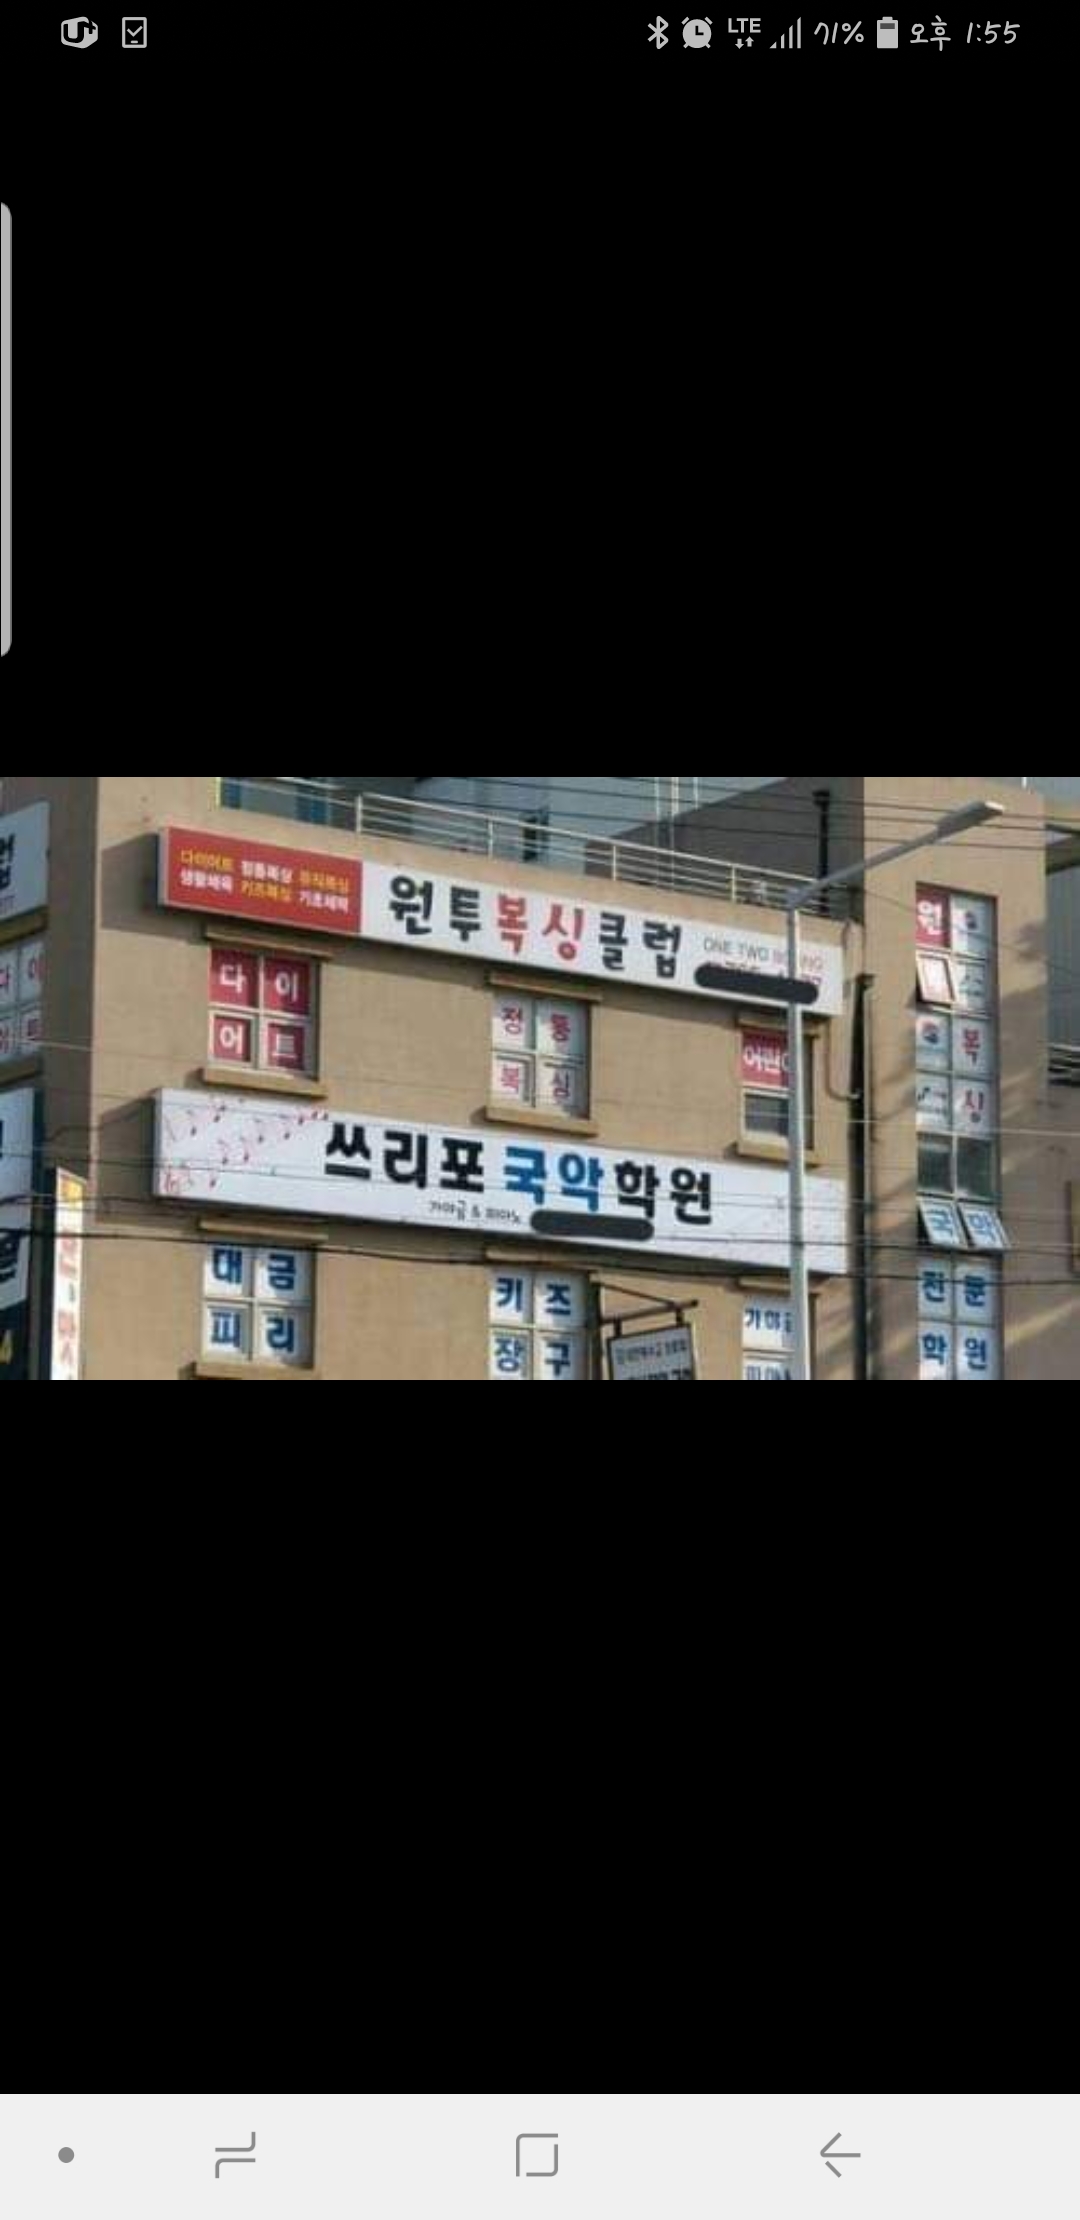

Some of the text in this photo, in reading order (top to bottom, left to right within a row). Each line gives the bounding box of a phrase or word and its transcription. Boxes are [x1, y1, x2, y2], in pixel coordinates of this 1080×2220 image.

[727, 17, 762, 34] LTE
[813, 20, 865, 46] 71%
[909, 15, 1021, 52] 오후 1:55
[704, 937, 733, 954] ONE
[736, 942, 769, 961] TWO
[325, 1122, 485, 1193] 쓰리포
[497, 1278, 571, 1316] 키즈
[495, 1338, 572, 1377] 장구
